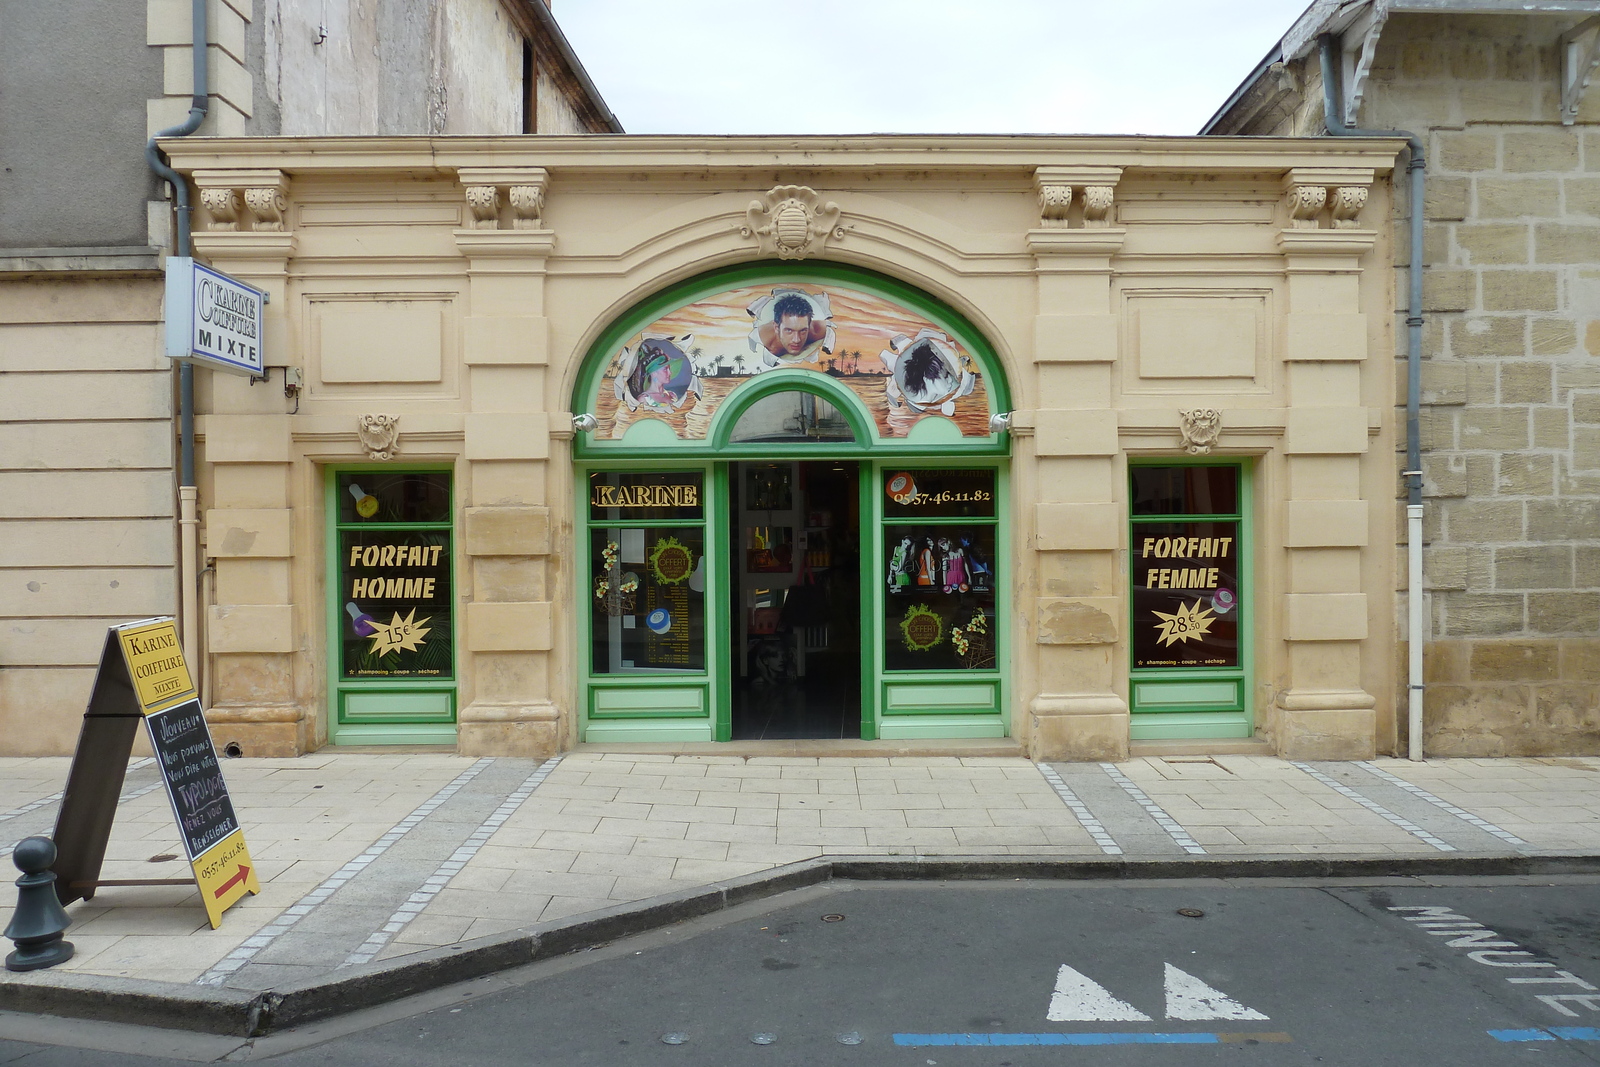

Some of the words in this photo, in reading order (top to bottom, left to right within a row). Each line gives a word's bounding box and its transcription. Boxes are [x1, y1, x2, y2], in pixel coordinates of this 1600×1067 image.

[214, 283, 256, 320] KARINE
[199, 329, 256, 362] MIXTE
[595, 485, 697, 507] KARINE
[893, 490, 991, 505] 05.57.46.11.82
[350, 545, 443, 567] FORFAIT
[1142, 537, 1232, 558] FORFAIT
[659, 558, 686, 567] OFFERT
[352, 577, 436, 598] HOMME
[1146, 568, 1219, 589] FEMME
[909, 624, 936, 633] OFFERT
[129, 634, 175, 656] KARINE
[136, 655, 184, 679] COIFFURE
[154, 679, 181, 695] MIXTE
[184, 814, 206, 832] VENEZ
[192, 817, 233, 851] RENSEIGNER
